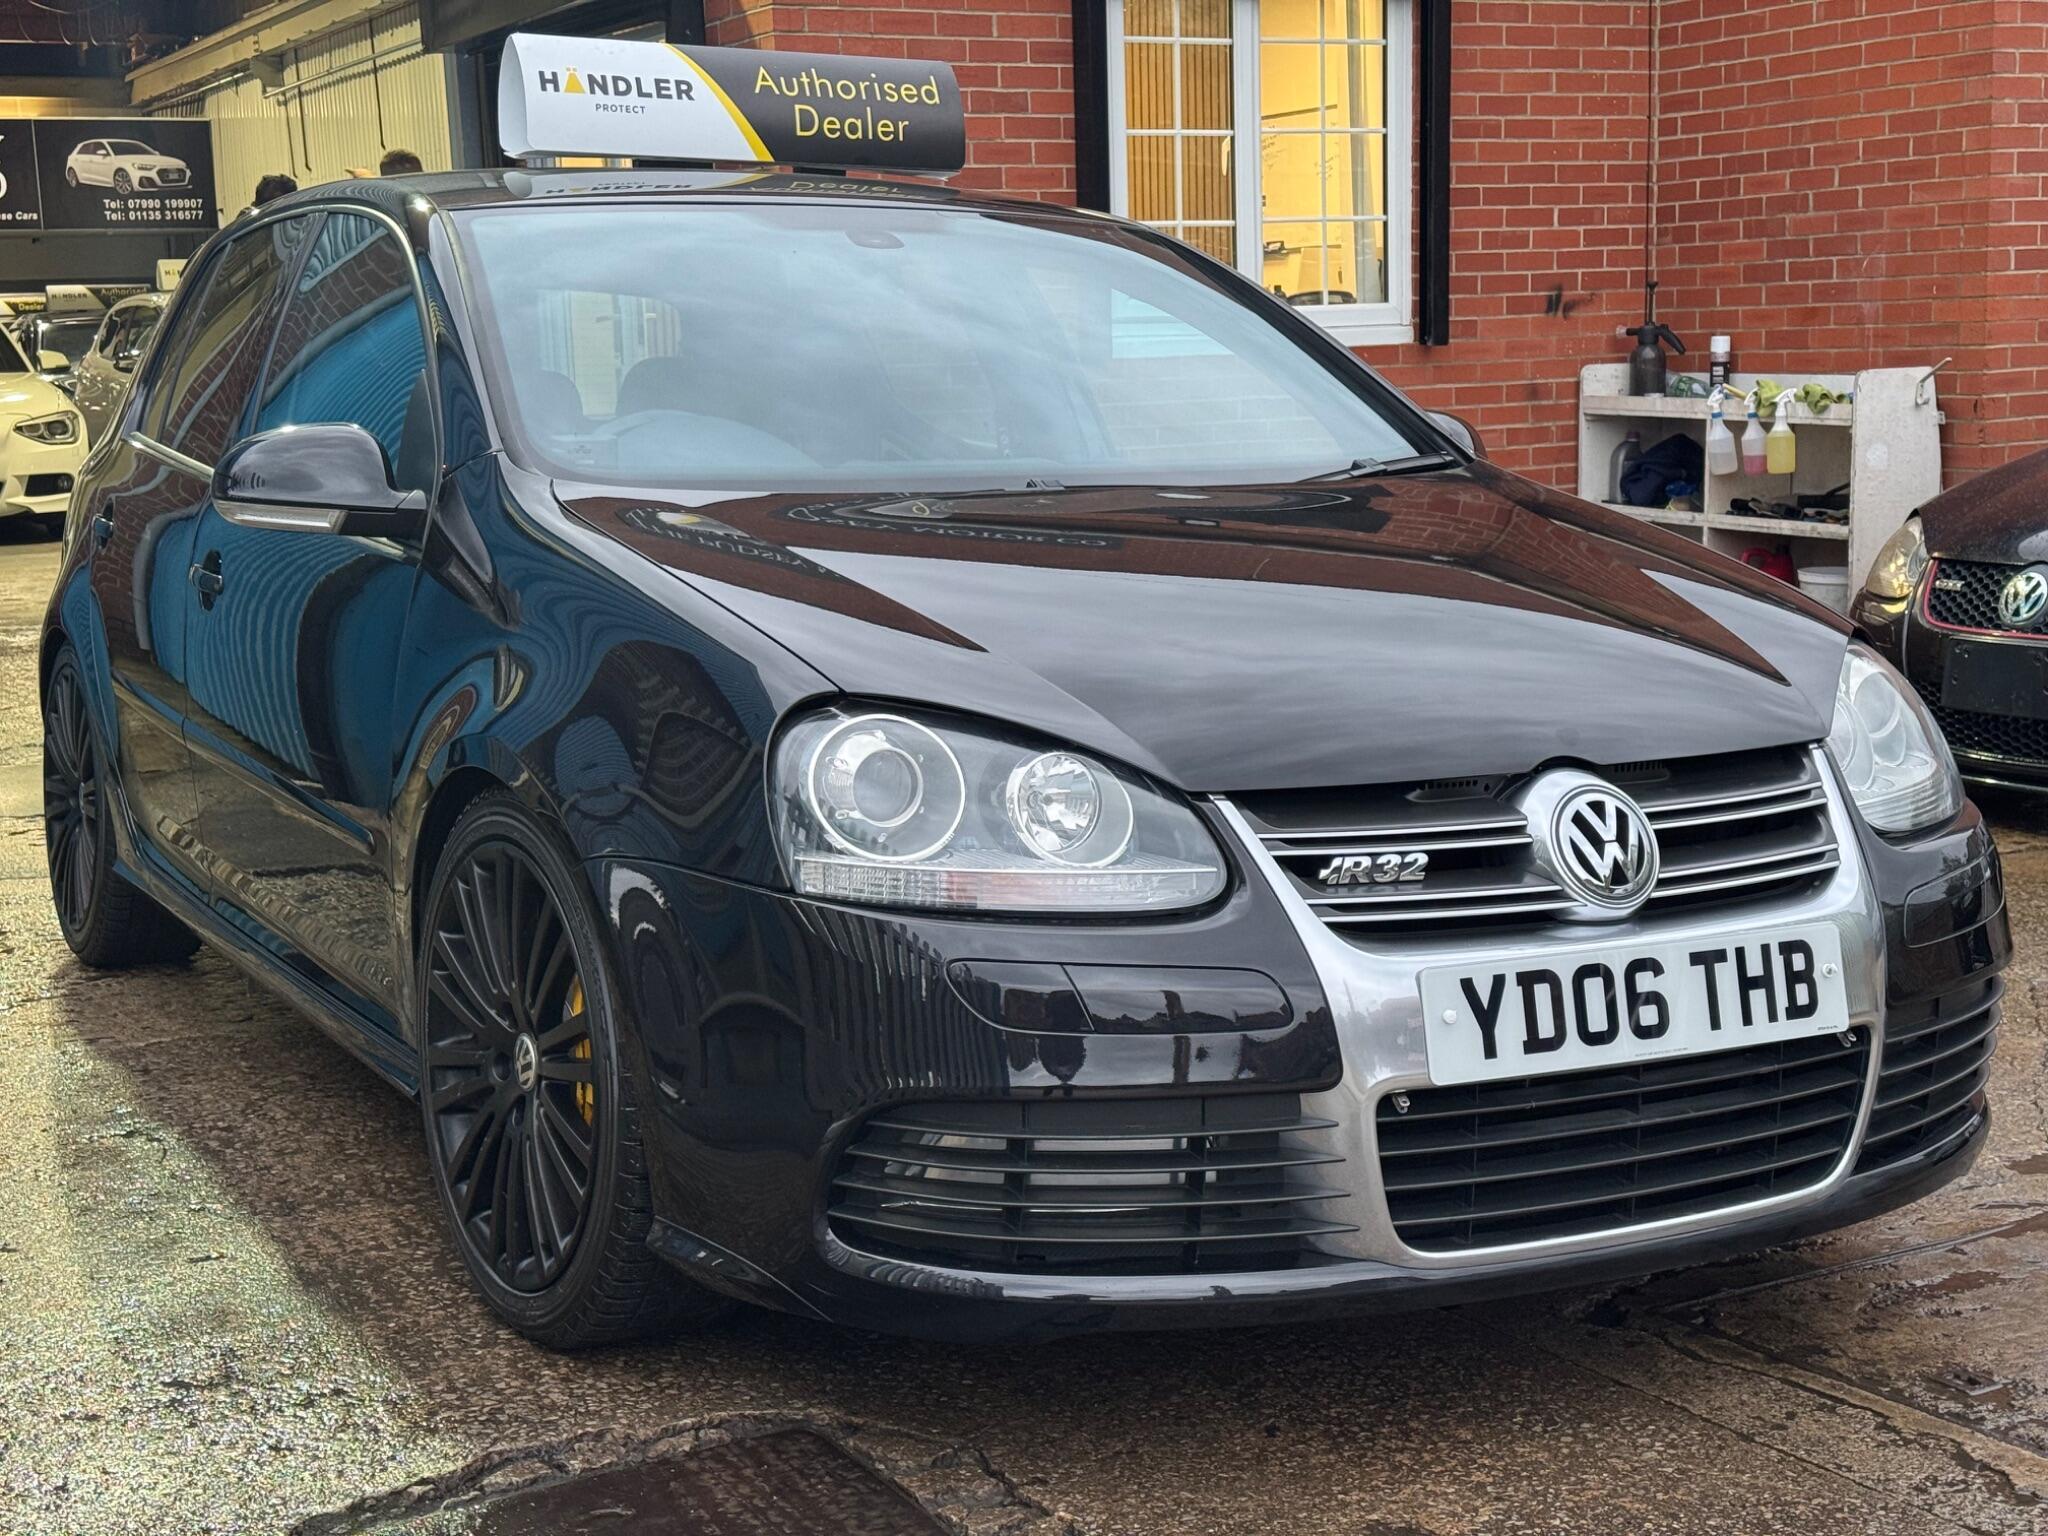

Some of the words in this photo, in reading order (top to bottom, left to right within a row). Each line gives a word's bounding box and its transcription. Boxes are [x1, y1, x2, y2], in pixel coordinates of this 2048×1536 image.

[754, 65, 941, 105] Authorised
[595, 103, 646, 115] PROTECT
[793, 103, 910, 142] Dealer
[103, 198, 124, 209] Tel:
[15, 210, 39, 221] Cars
[104, 210, 125, 221] Tel:
[128, 210, 162, 221] 01135
[101, 286, 147, 297] Authorised
[1459, 956, 1671, 1061] YD06
[1688, 938, 1820, 1032] THB
